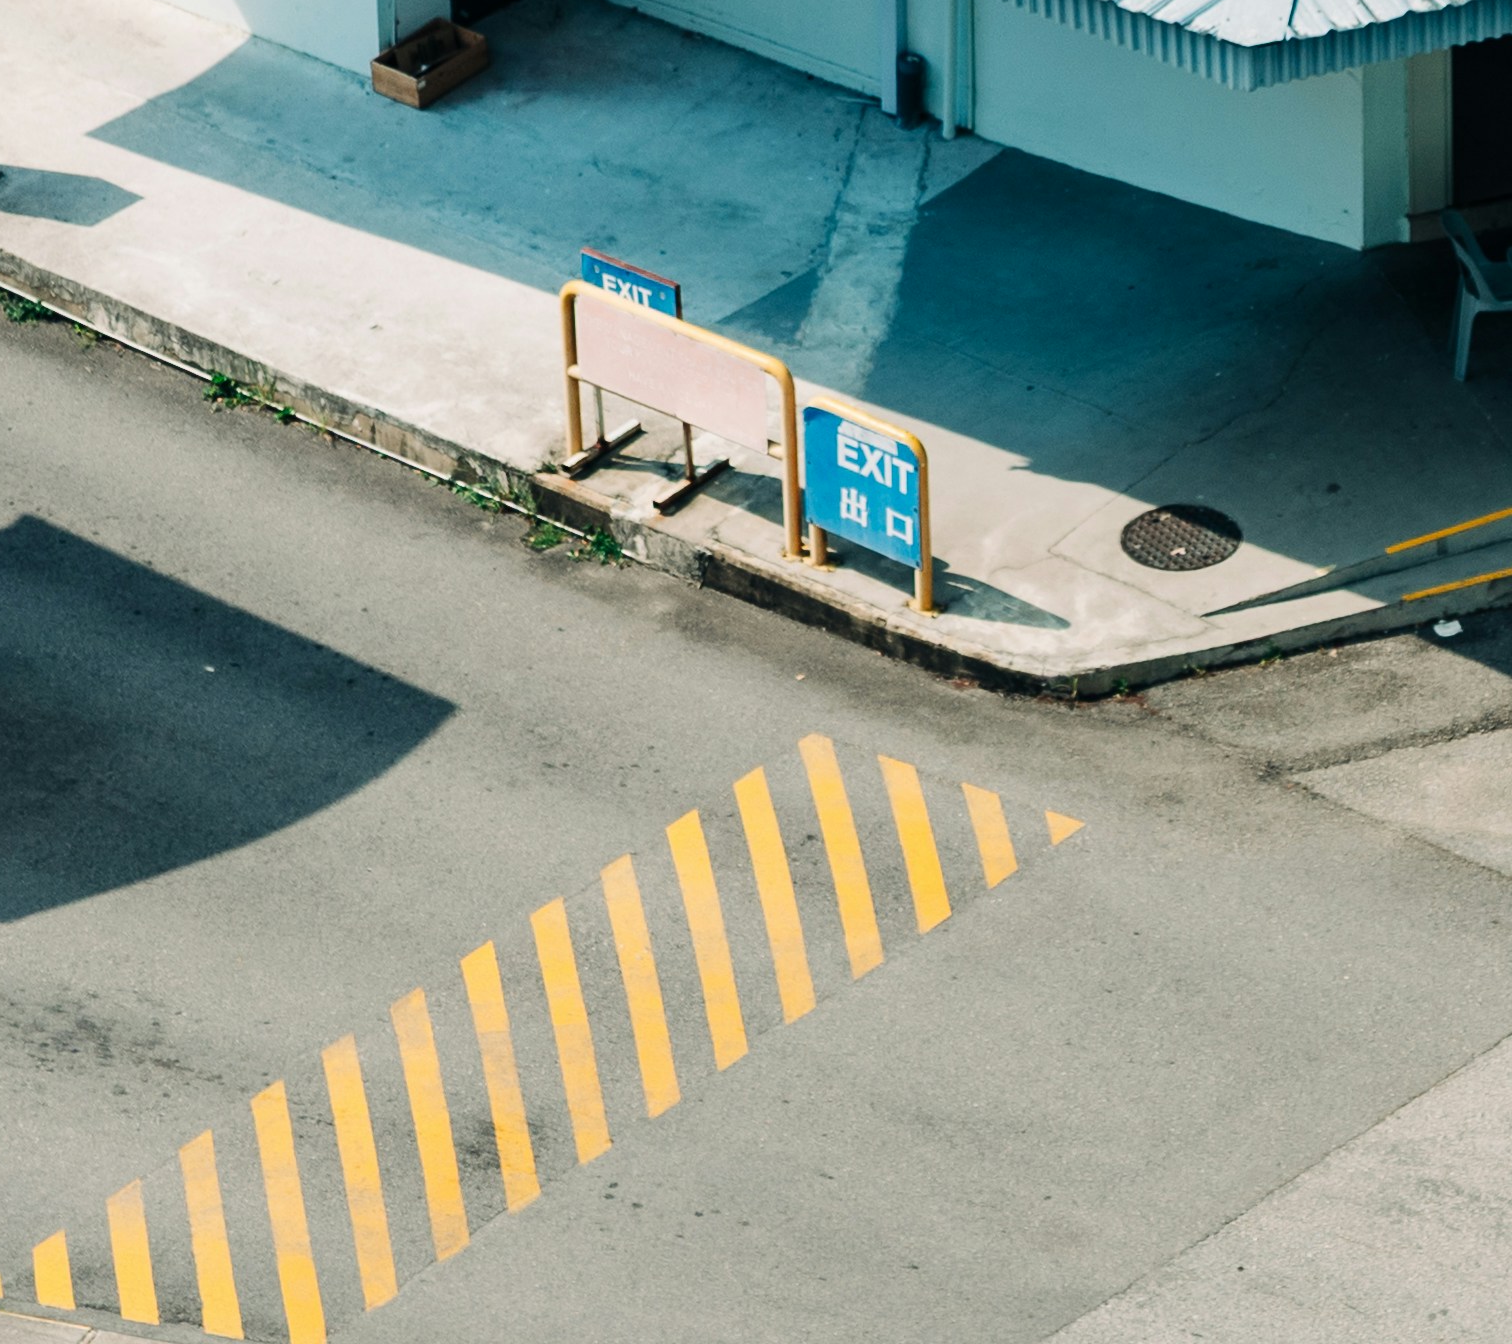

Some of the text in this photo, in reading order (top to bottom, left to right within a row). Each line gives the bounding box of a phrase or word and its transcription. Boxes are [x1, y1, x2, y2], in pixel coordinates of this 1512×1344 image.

[601, 272, 652, 307] EXIT
[837, 434, 915, 495] EXIT
[840, 487, 913, 545] 出口
